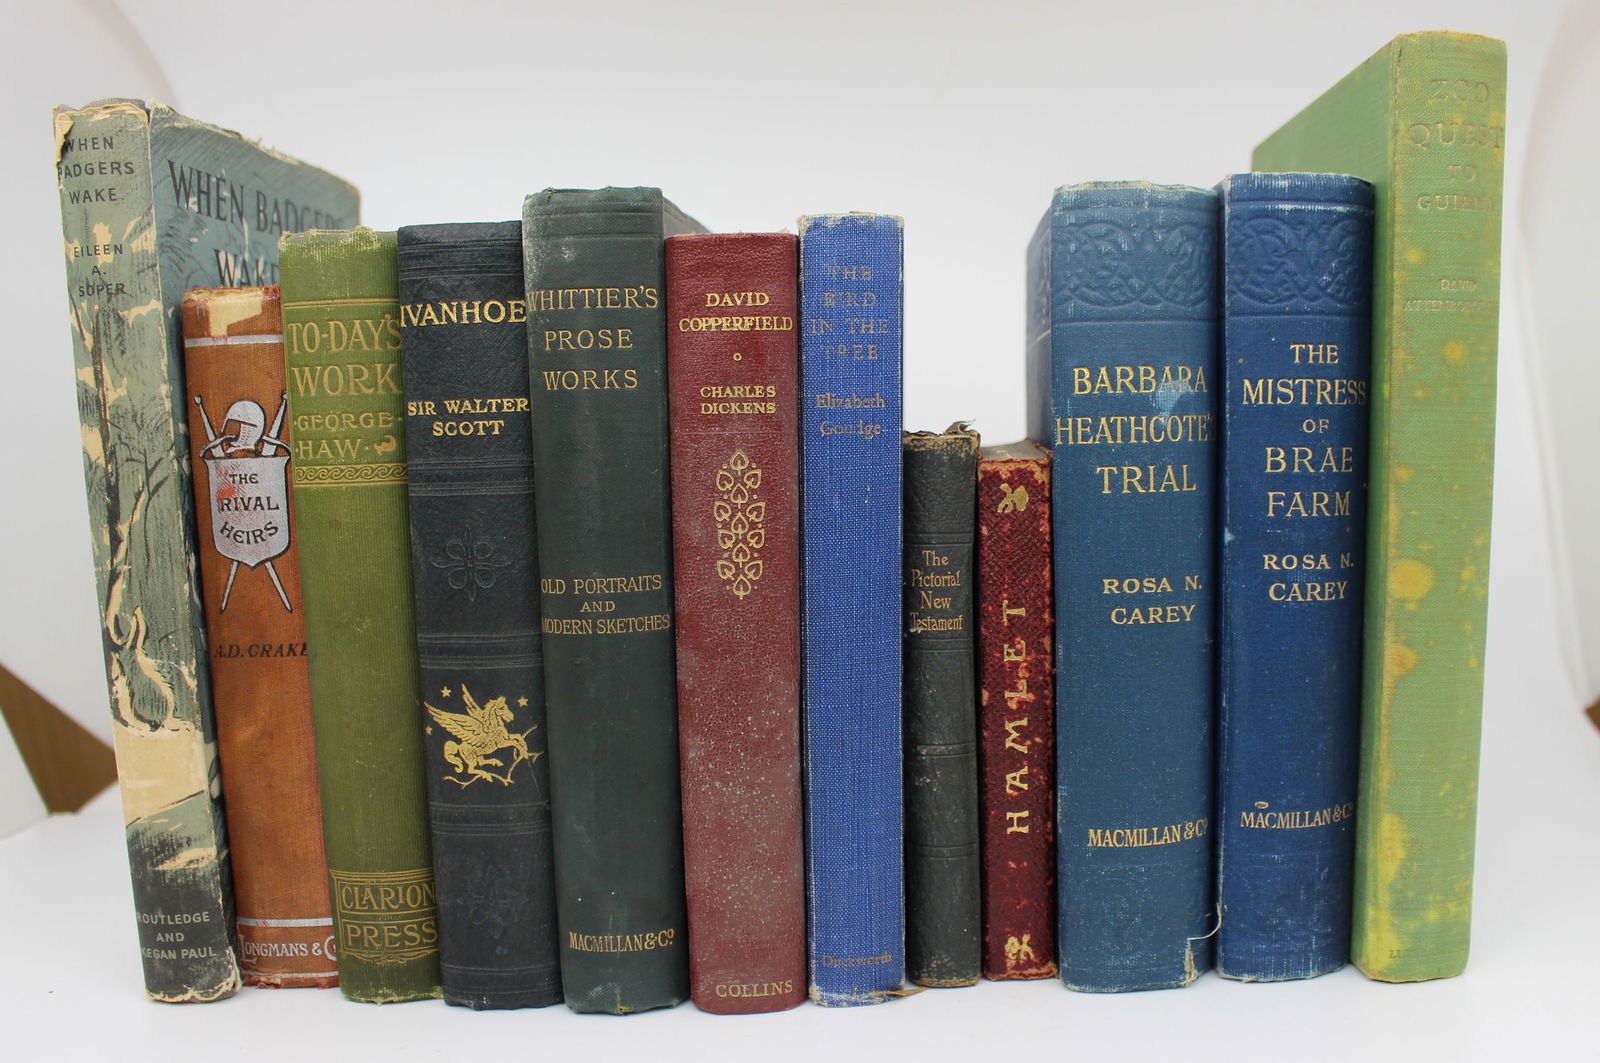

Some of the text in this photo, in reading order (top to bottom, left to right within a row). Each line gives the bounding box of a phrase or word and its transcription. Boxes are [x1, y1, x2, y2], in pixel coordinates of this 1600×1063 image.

[64, 136, 114, 152] WHEN
[1407, 121, 1504, 150] QUEST
[69, 187, 118, 205] WAKE
[167, 158, 345, 234] WHEN BADG
[73, 243, 124, 259] EILEEN
[78, 283, 128, 298] SOPER
[526, 285, 659, 312] WHITTIER'S
[705, 291, 770, 307] DAVID
[400, 300, 527, 328] IVANHOE
[678, 316, 793, 332] COPPERFIELD
[287, 313, 401, 354] TO-DAY'S
[810, 318, 889, 334] IN THE
[544, 328, 634, 351] PROSE
[1289, 344, 1340, 364] THE
[291, 363, 401, 397] WORK
[543, 368, 639, 391] WORKS
[1072, 365, 1208, 395] BARBARA
[700, 385, 777, 399] CHARLES
[1242, 378, 1367, 406] MISTRESS
[407, 397, 530, 417] SIR WALTER
[700, 402, 777, 415] DICKENS
[432, 419, 505, 437] SCOTT
[1302, 418, 1330, 433] OF
[1264, 446, 1353, 473] BRAE
[228, 473, 259, 485] THE
[1095, 464, 1198, 494] TRIAL
[220, 496, 280, 512] RIVAL
[1266, 491, 1351, 517] FARM
[219, 520, 279, 545] HEIRS
[922, 549, 950, 566] The
[1263, 552, 1355, 570] ROSA N.
[541, 574, 662, 595] OLD PORTRAITS
[911, 568, 961, 588] Pictorial
[1102, 575, 1203, 594] ROSA N.
[920, 590, 952, 609] New
[1269, 580, 1348, 602] CAREY
[580, 600, 616, 613] AND
[1110, 604, 1197, 625] CAREY
[541, 614, 671, 635] MODERN SKETCHES
[910, 611, 965, 632] Testament
[1003, 600, 1030, 835] HAMLET
[341, 881, 436, 910] CLARION
[136, 911, 211, 926] ROUTLEDGE
[156, 932, 185, 943] AND
[345, 921, 438, 948] PRESS
[142, 946, 217, 960] KEGAN PAUL
[238, 934, 309, 964] LONGMANS
[311, 942, 323, 955] &
[715, 979, 793, 998] COLLINS
